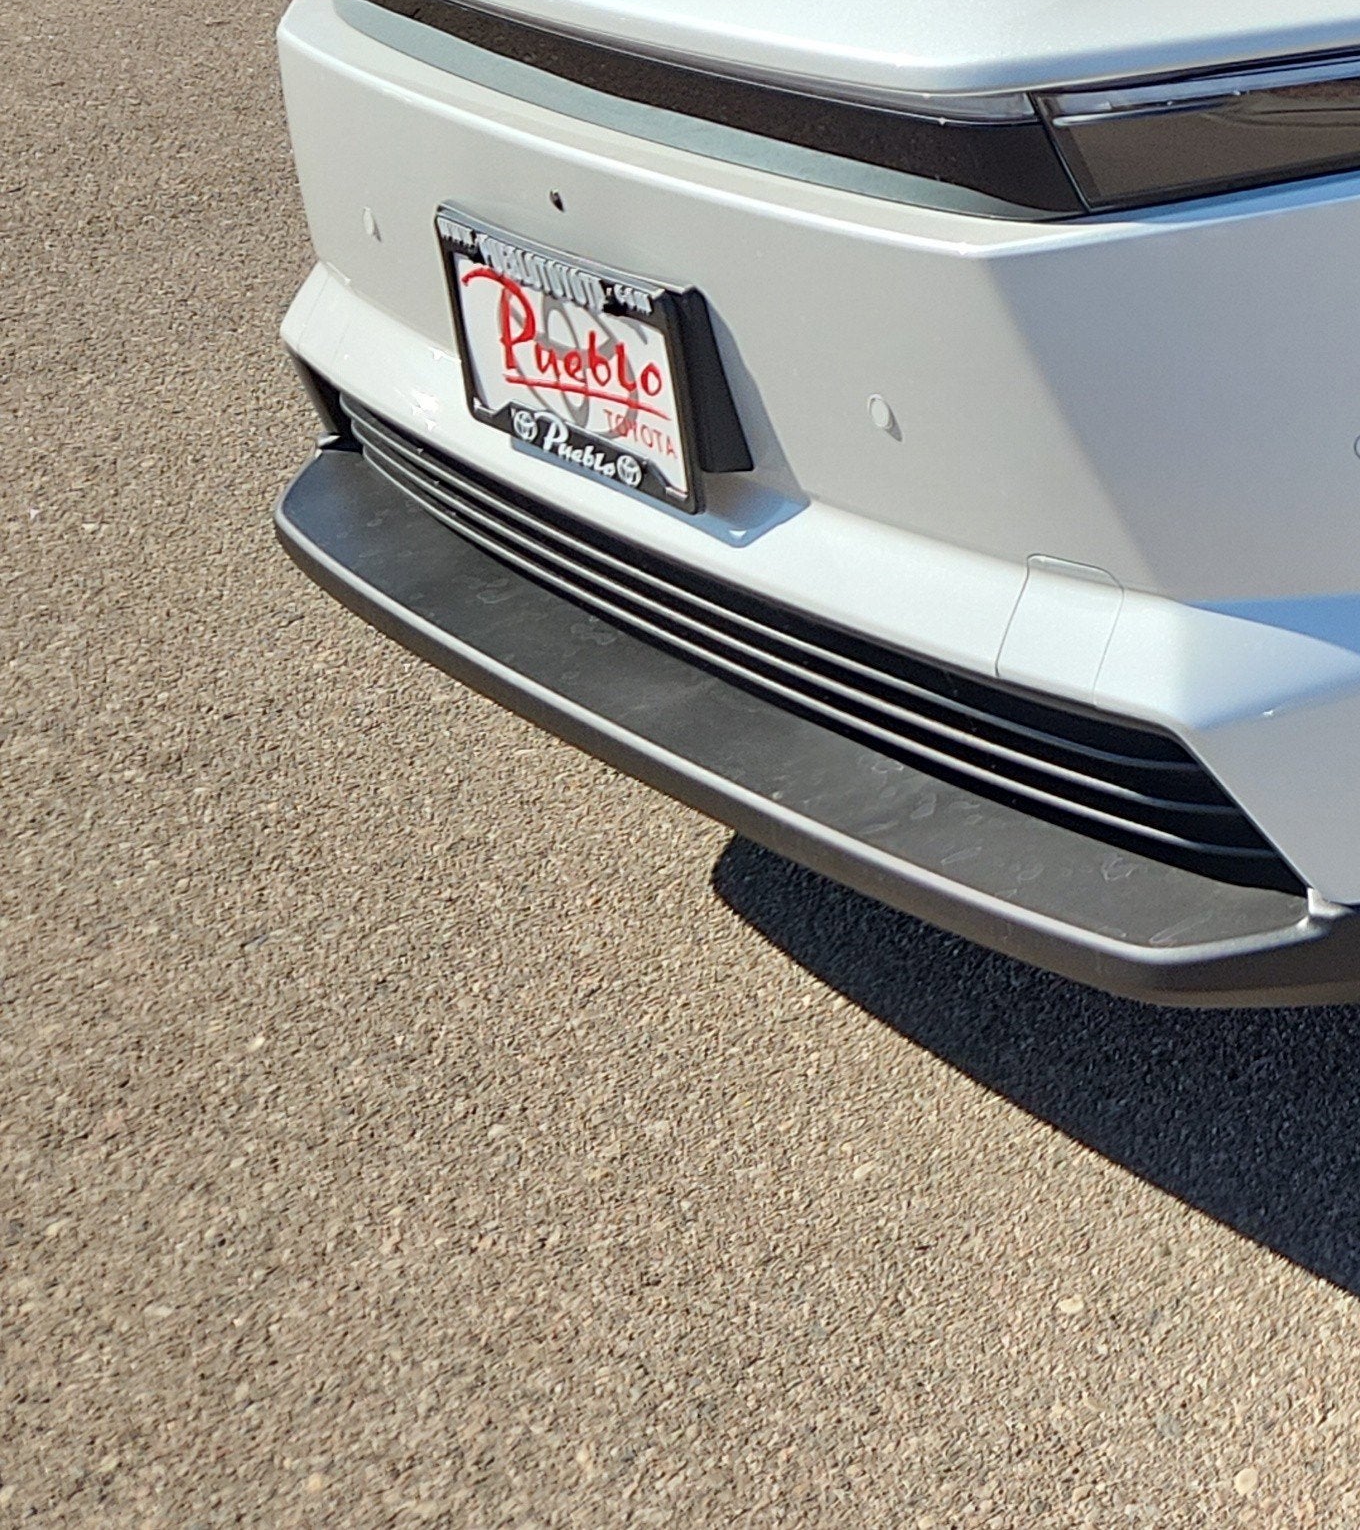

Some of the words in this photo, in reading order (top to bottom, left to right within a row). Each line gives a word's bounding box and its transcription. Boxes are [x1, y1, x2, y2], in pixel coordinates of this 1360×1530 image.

[461, 263, 662, 396] Pueblo
[533, 410, 616, 478] Pueblo
[603, 408, 678, 459] TOYOTA
